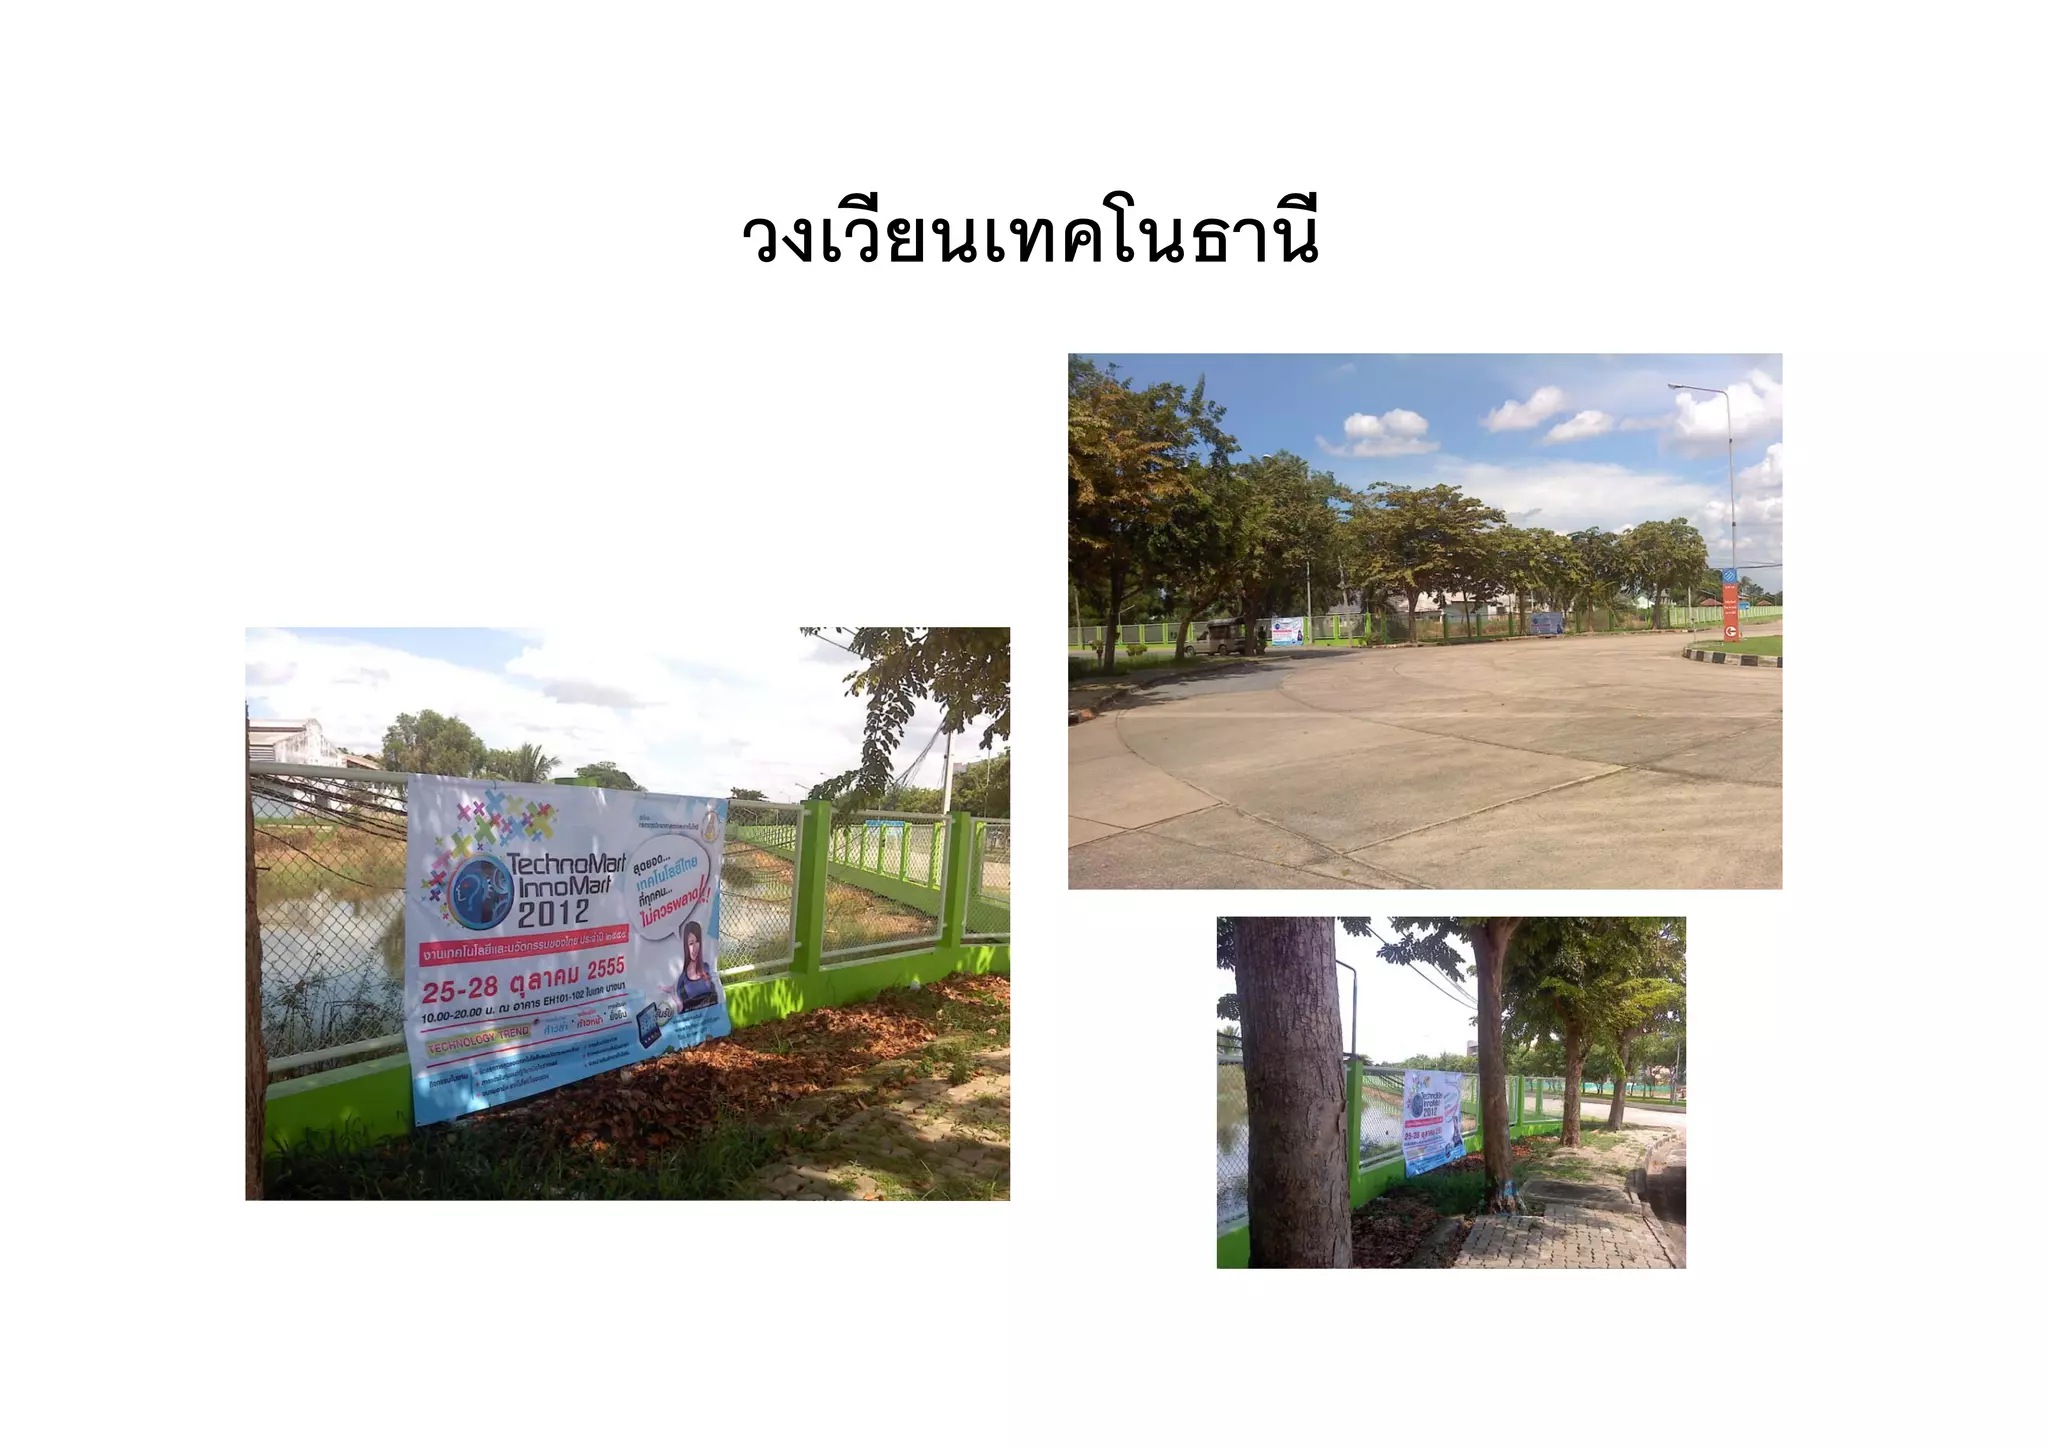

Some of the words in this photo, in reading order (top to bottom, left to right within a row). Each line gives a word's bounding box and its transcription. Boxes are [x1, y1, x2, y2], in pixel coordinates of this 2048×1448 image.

[507, 853, 626, 875] TechnoMart
[636, 856, 698, 892] เทคโนโลยีไทย
[519, 875, 611, 898] InnoMart
[518, 899, 589, 928] 2012
[421, 975, 498, 1004] 25-28
[510, 966, 579, 999] ตุลาคม
[588, 956, 625, 981] 2555
[421, 1007, 482, 1024] 10.00-20.00
[485, 1007, 495, 1016] น.
[513, 999, 541, 1012] อาคาร
[543, 989, 585, 1006] EH101-102
[427, 1031, 495, 1054] TECHNOLOGY
[498, 1026, 529, 1040] TREND
